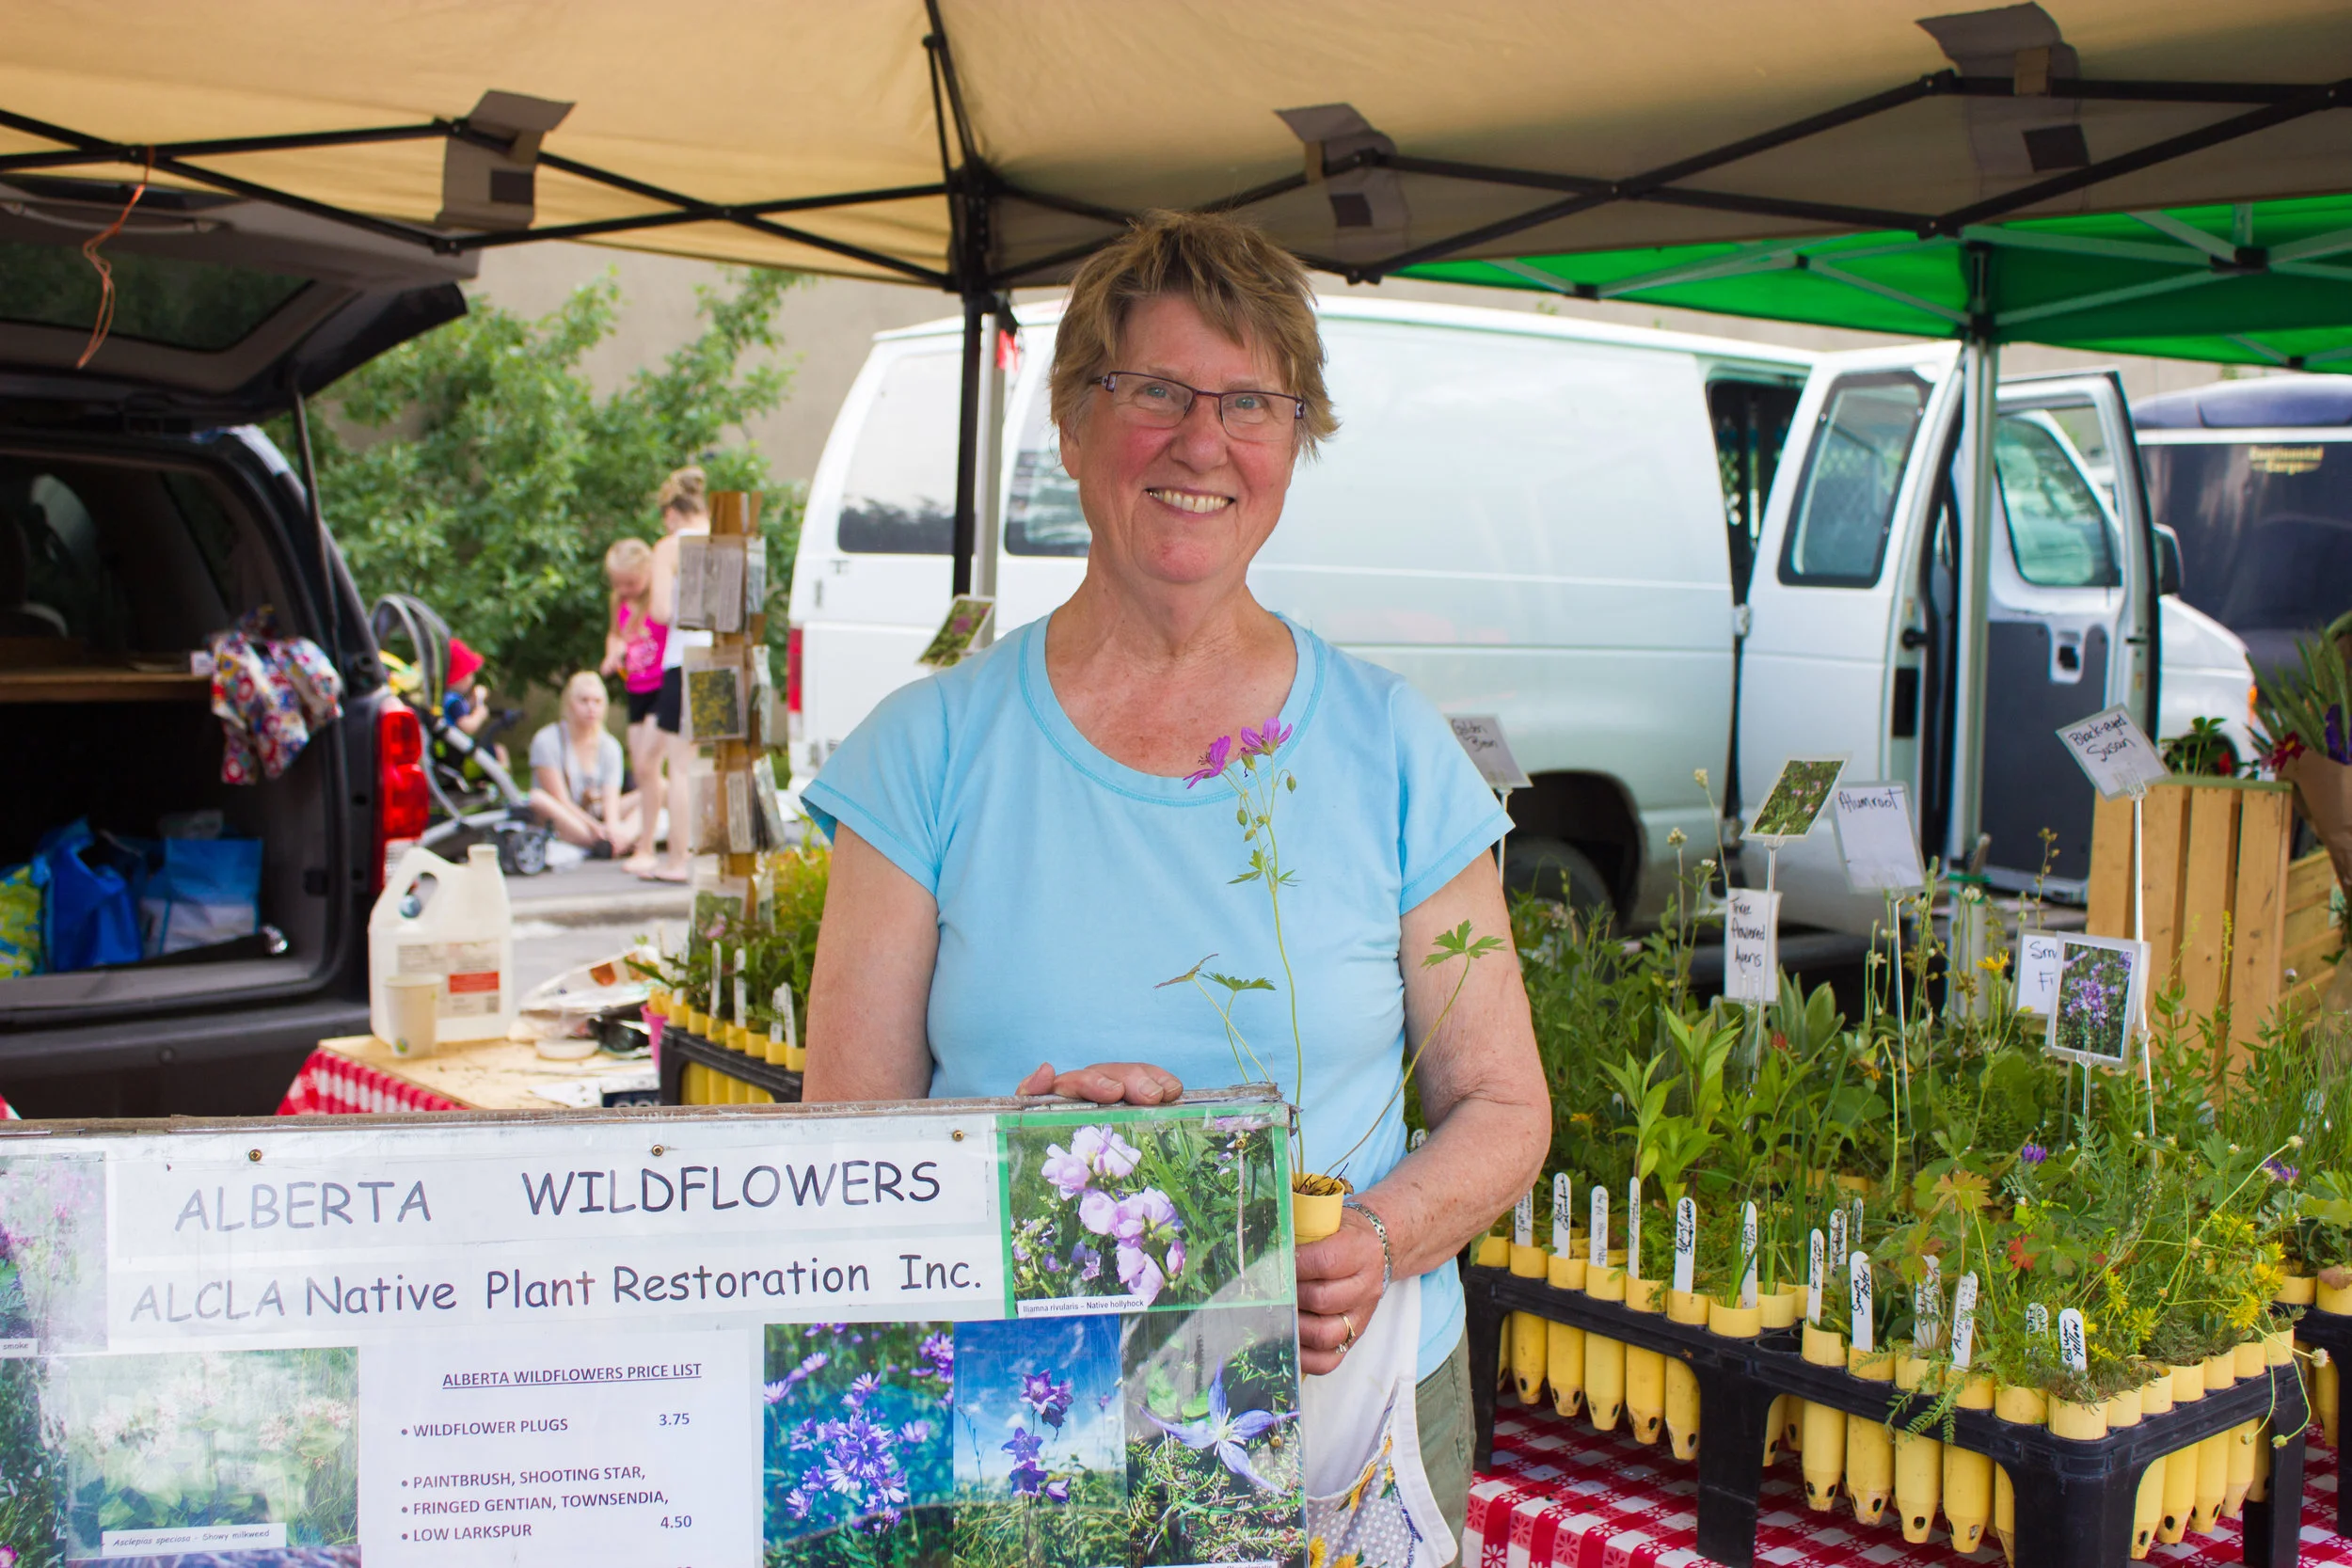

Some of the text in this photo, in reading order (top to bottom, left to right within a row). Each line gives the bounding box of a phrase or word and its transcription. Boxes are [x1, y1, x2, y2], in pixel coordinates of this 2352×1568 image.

[2086, 737, 2137, 762] Susan
[175, 1160, 940, 1231] ALBERTA WILDFLOWERS
[131, 1255, 980, 1323] ALCLA Native Plant Restoration Inc.
[1857, 1265, 1870, 1300] Aster
[1050, 1300, 1079, 1311] rivularis
[1087, 1298, 1108, 1309] Native
[1110, 1299, 1144, 1309] hollyhock
[2062, 1320, 2073, 1362] edum
[443, 1363, 702, 1386] ALBERTA WILDFLOWERS PRICE LIST
[414, 1413, 690, 1437] WILDFLOWER PLUGS 3.75
[414, 1466, 645, 1488] PAINTBRUSH, SHOOTING STAR,
[414, 1491, 668, 1514] FRINGED GENTIAN, TOWNSENDIA,
[113, 1537, 152, 1547] Asclepias
[156, 1535, 191, 1545] speciosa
[202, 1532, 229, 1542] Showy
[232, 1529, 270, 1539] milkweed
[414, 1515, 691, 1542] LOW LARKSPUR 4.50
